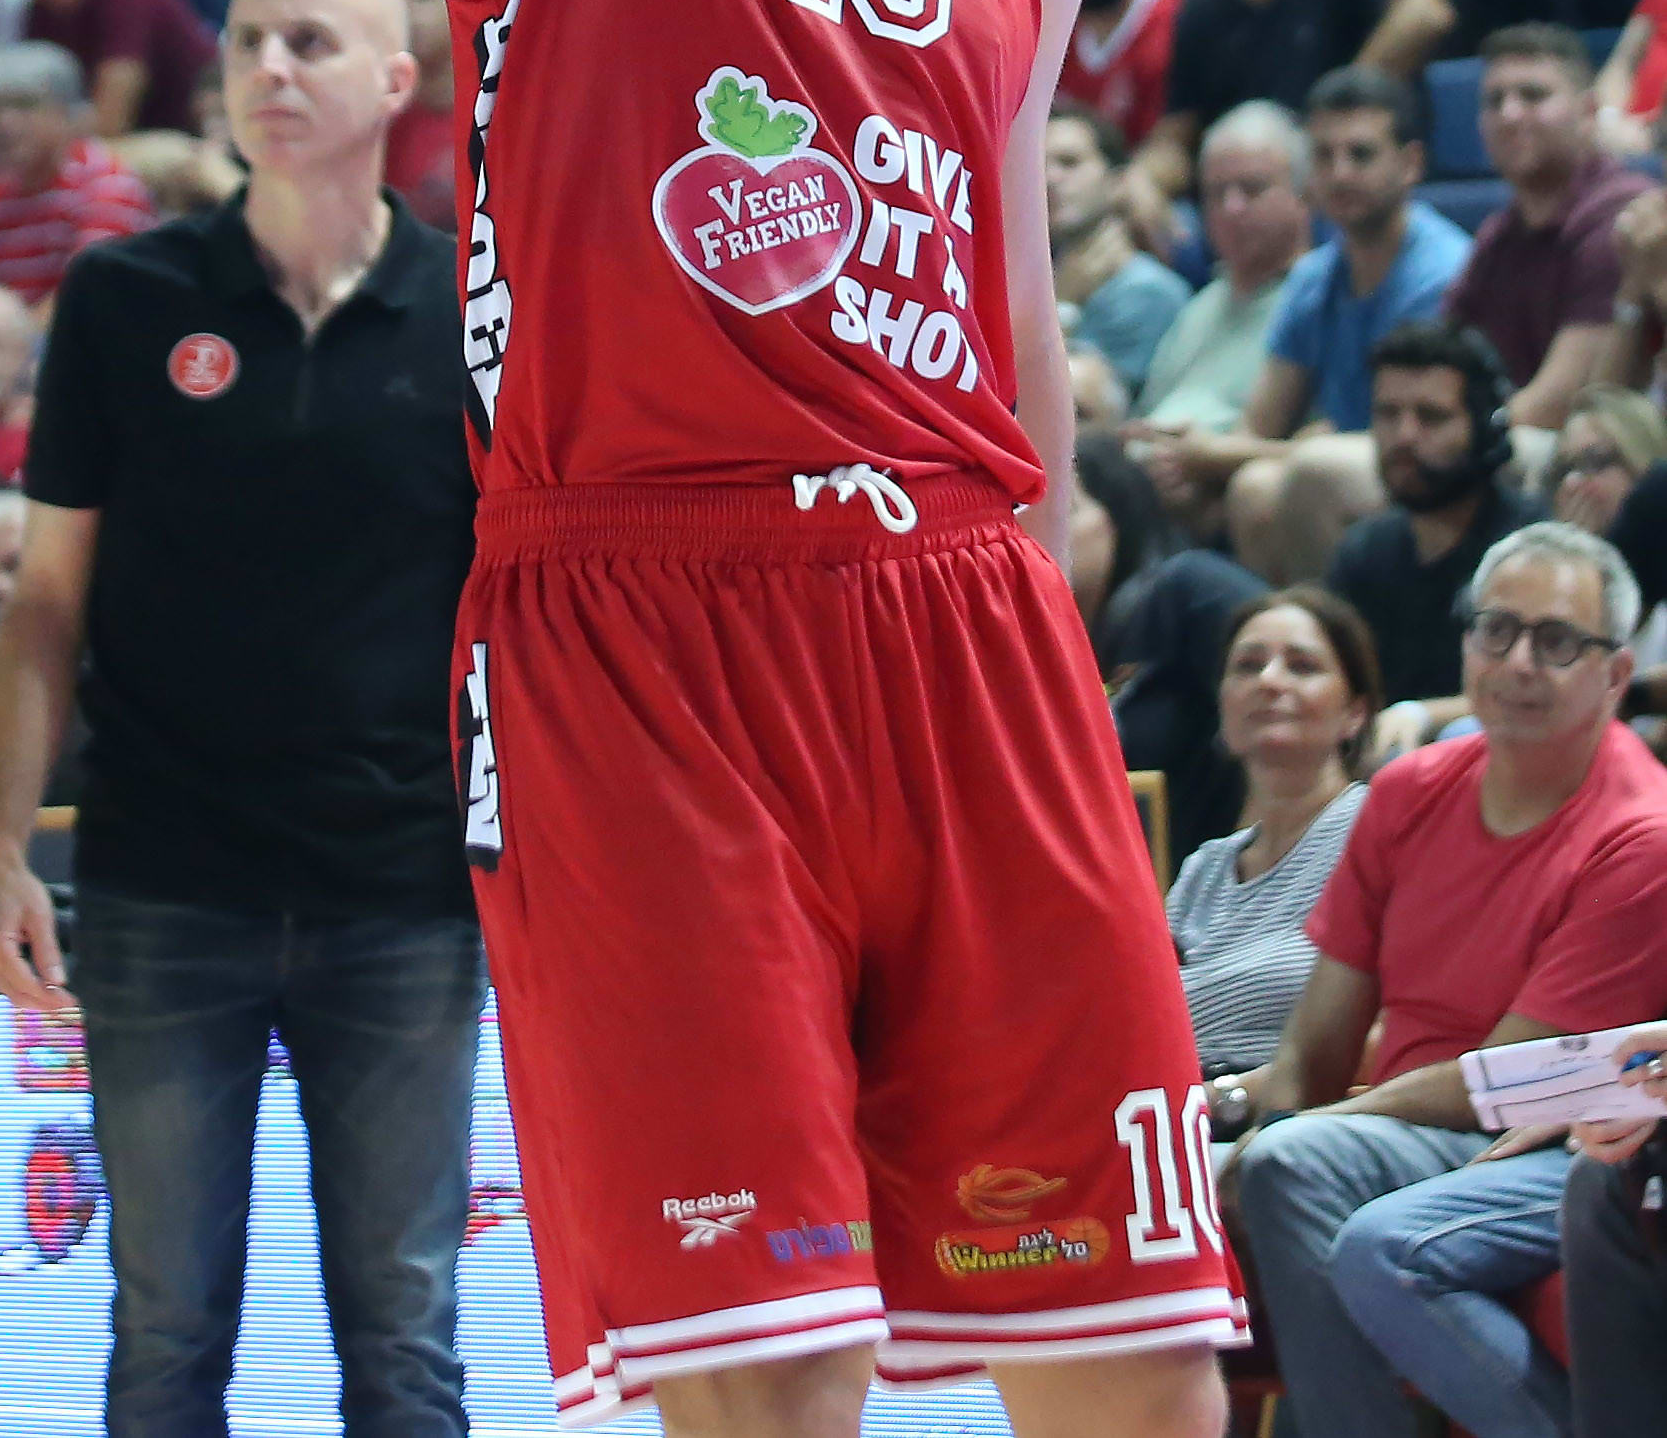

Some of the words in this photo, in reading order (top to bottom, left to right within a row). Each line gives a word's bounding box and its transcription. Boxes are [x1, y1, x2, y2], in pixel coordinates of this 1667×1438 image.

[707, 175, 827, 226] VEGAN
[693, 202, 842, 270] FRIENDLY
[859, 198, 934, 279] IT
[941, 234, 968, 310] A
[662, 1188, 757, 1221] Reebok
[952, 1242, 1058, 1270] Winner
